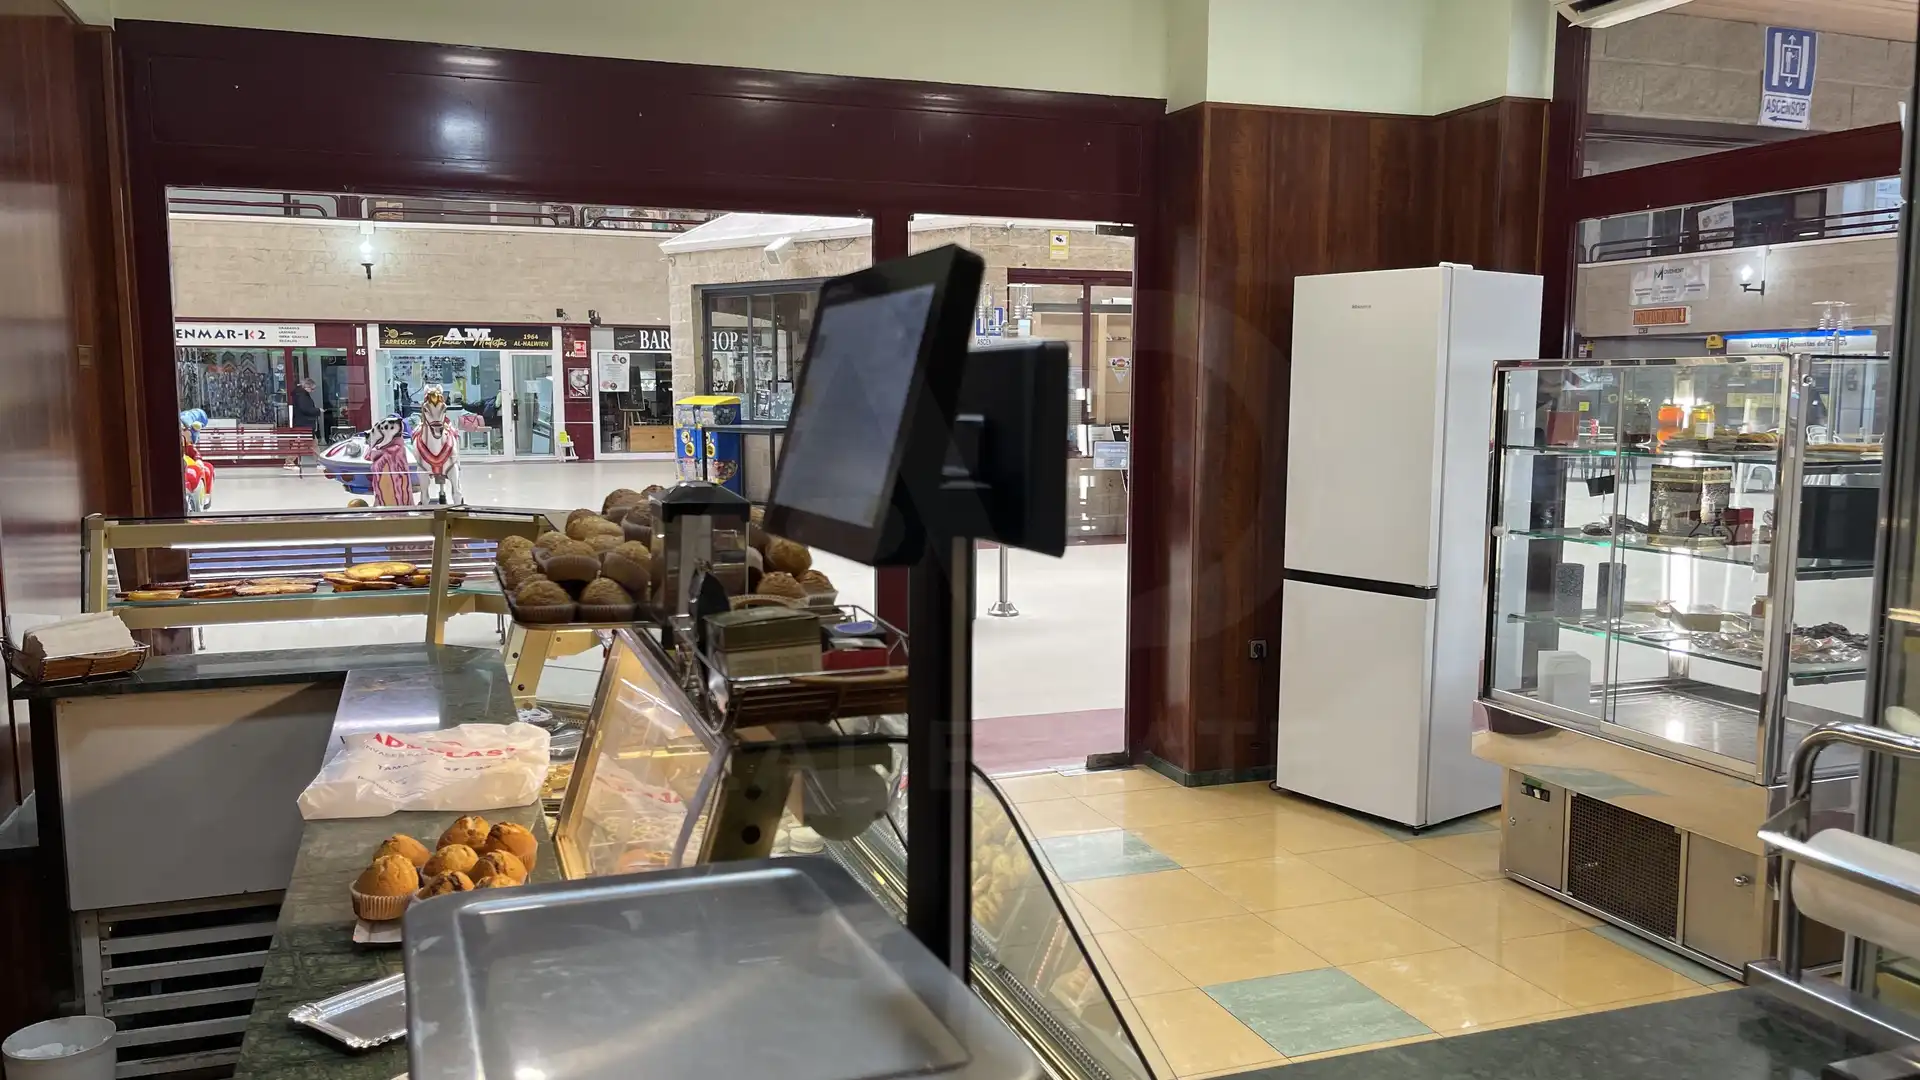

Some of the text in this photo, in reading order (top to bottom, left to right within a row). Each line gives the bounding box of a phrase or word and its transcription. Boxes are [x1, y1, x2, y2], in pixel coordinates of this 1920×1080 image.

[1764, 98, 1807, 117] ASCENSOR
[443, 327, 492, 342] AM
[639, 329, 671, 350] BAR
[355, 348, 366, 356] 45
